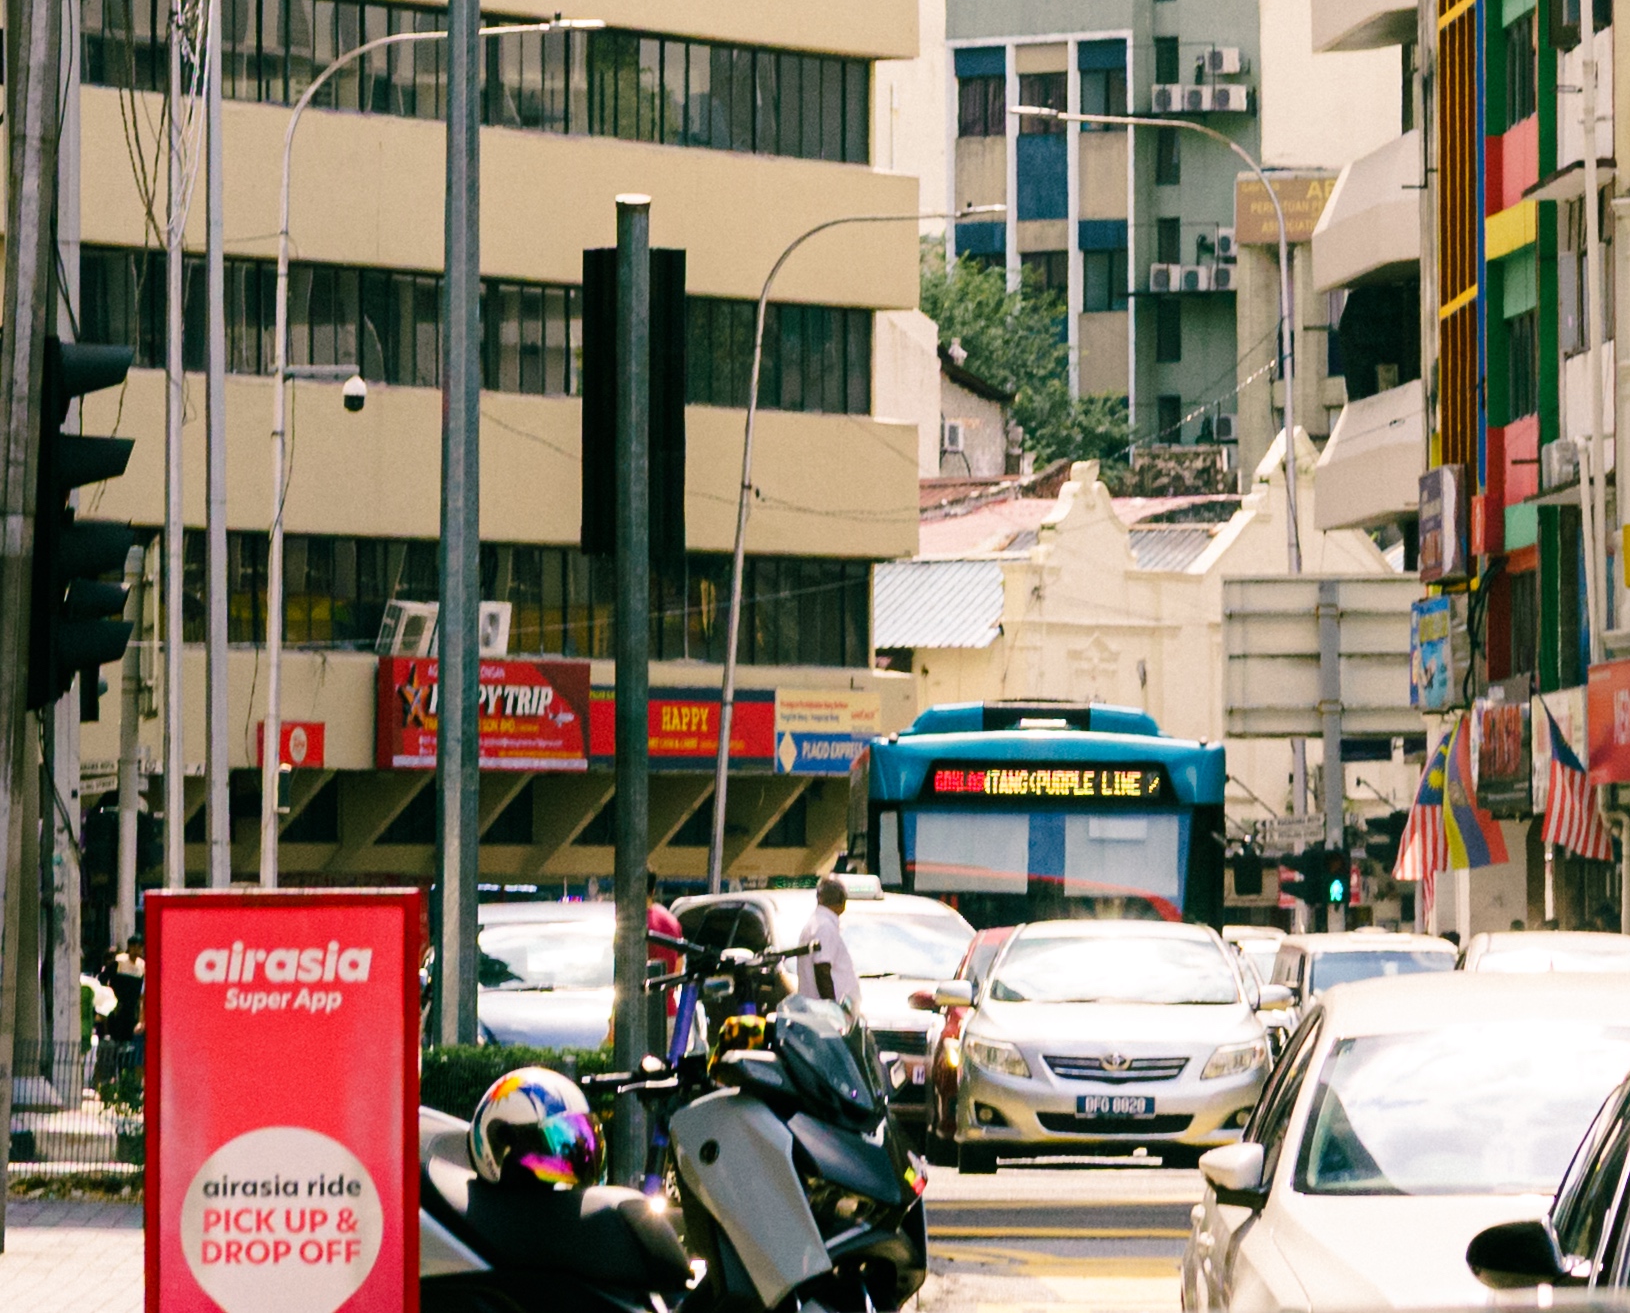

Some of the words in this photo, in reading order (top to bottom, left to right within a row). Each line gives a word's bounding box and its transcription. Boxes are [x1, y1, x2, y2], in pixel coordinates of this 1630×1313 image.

[503, 685, 554, 716] TRIP
[661, 705, 709, 732] HAPPY
[1101, 771, 1142, 796] LINE
[194, 940, 373, 984] airasia
[225, 988, 293, 1015] Super
[293, 988, 342, 1015] App
[203, 1174, 298, 1197] airasia
[307, 1174, 361, 1197] ride
[203, 1207, 276, 1235] PICK
[284, 1207, 328, 1234] UP
[336, 1206, 359, 1235] &
[201, 1237, 292, 1265] DROP
[299, 1237, 362, 1265] OFF
